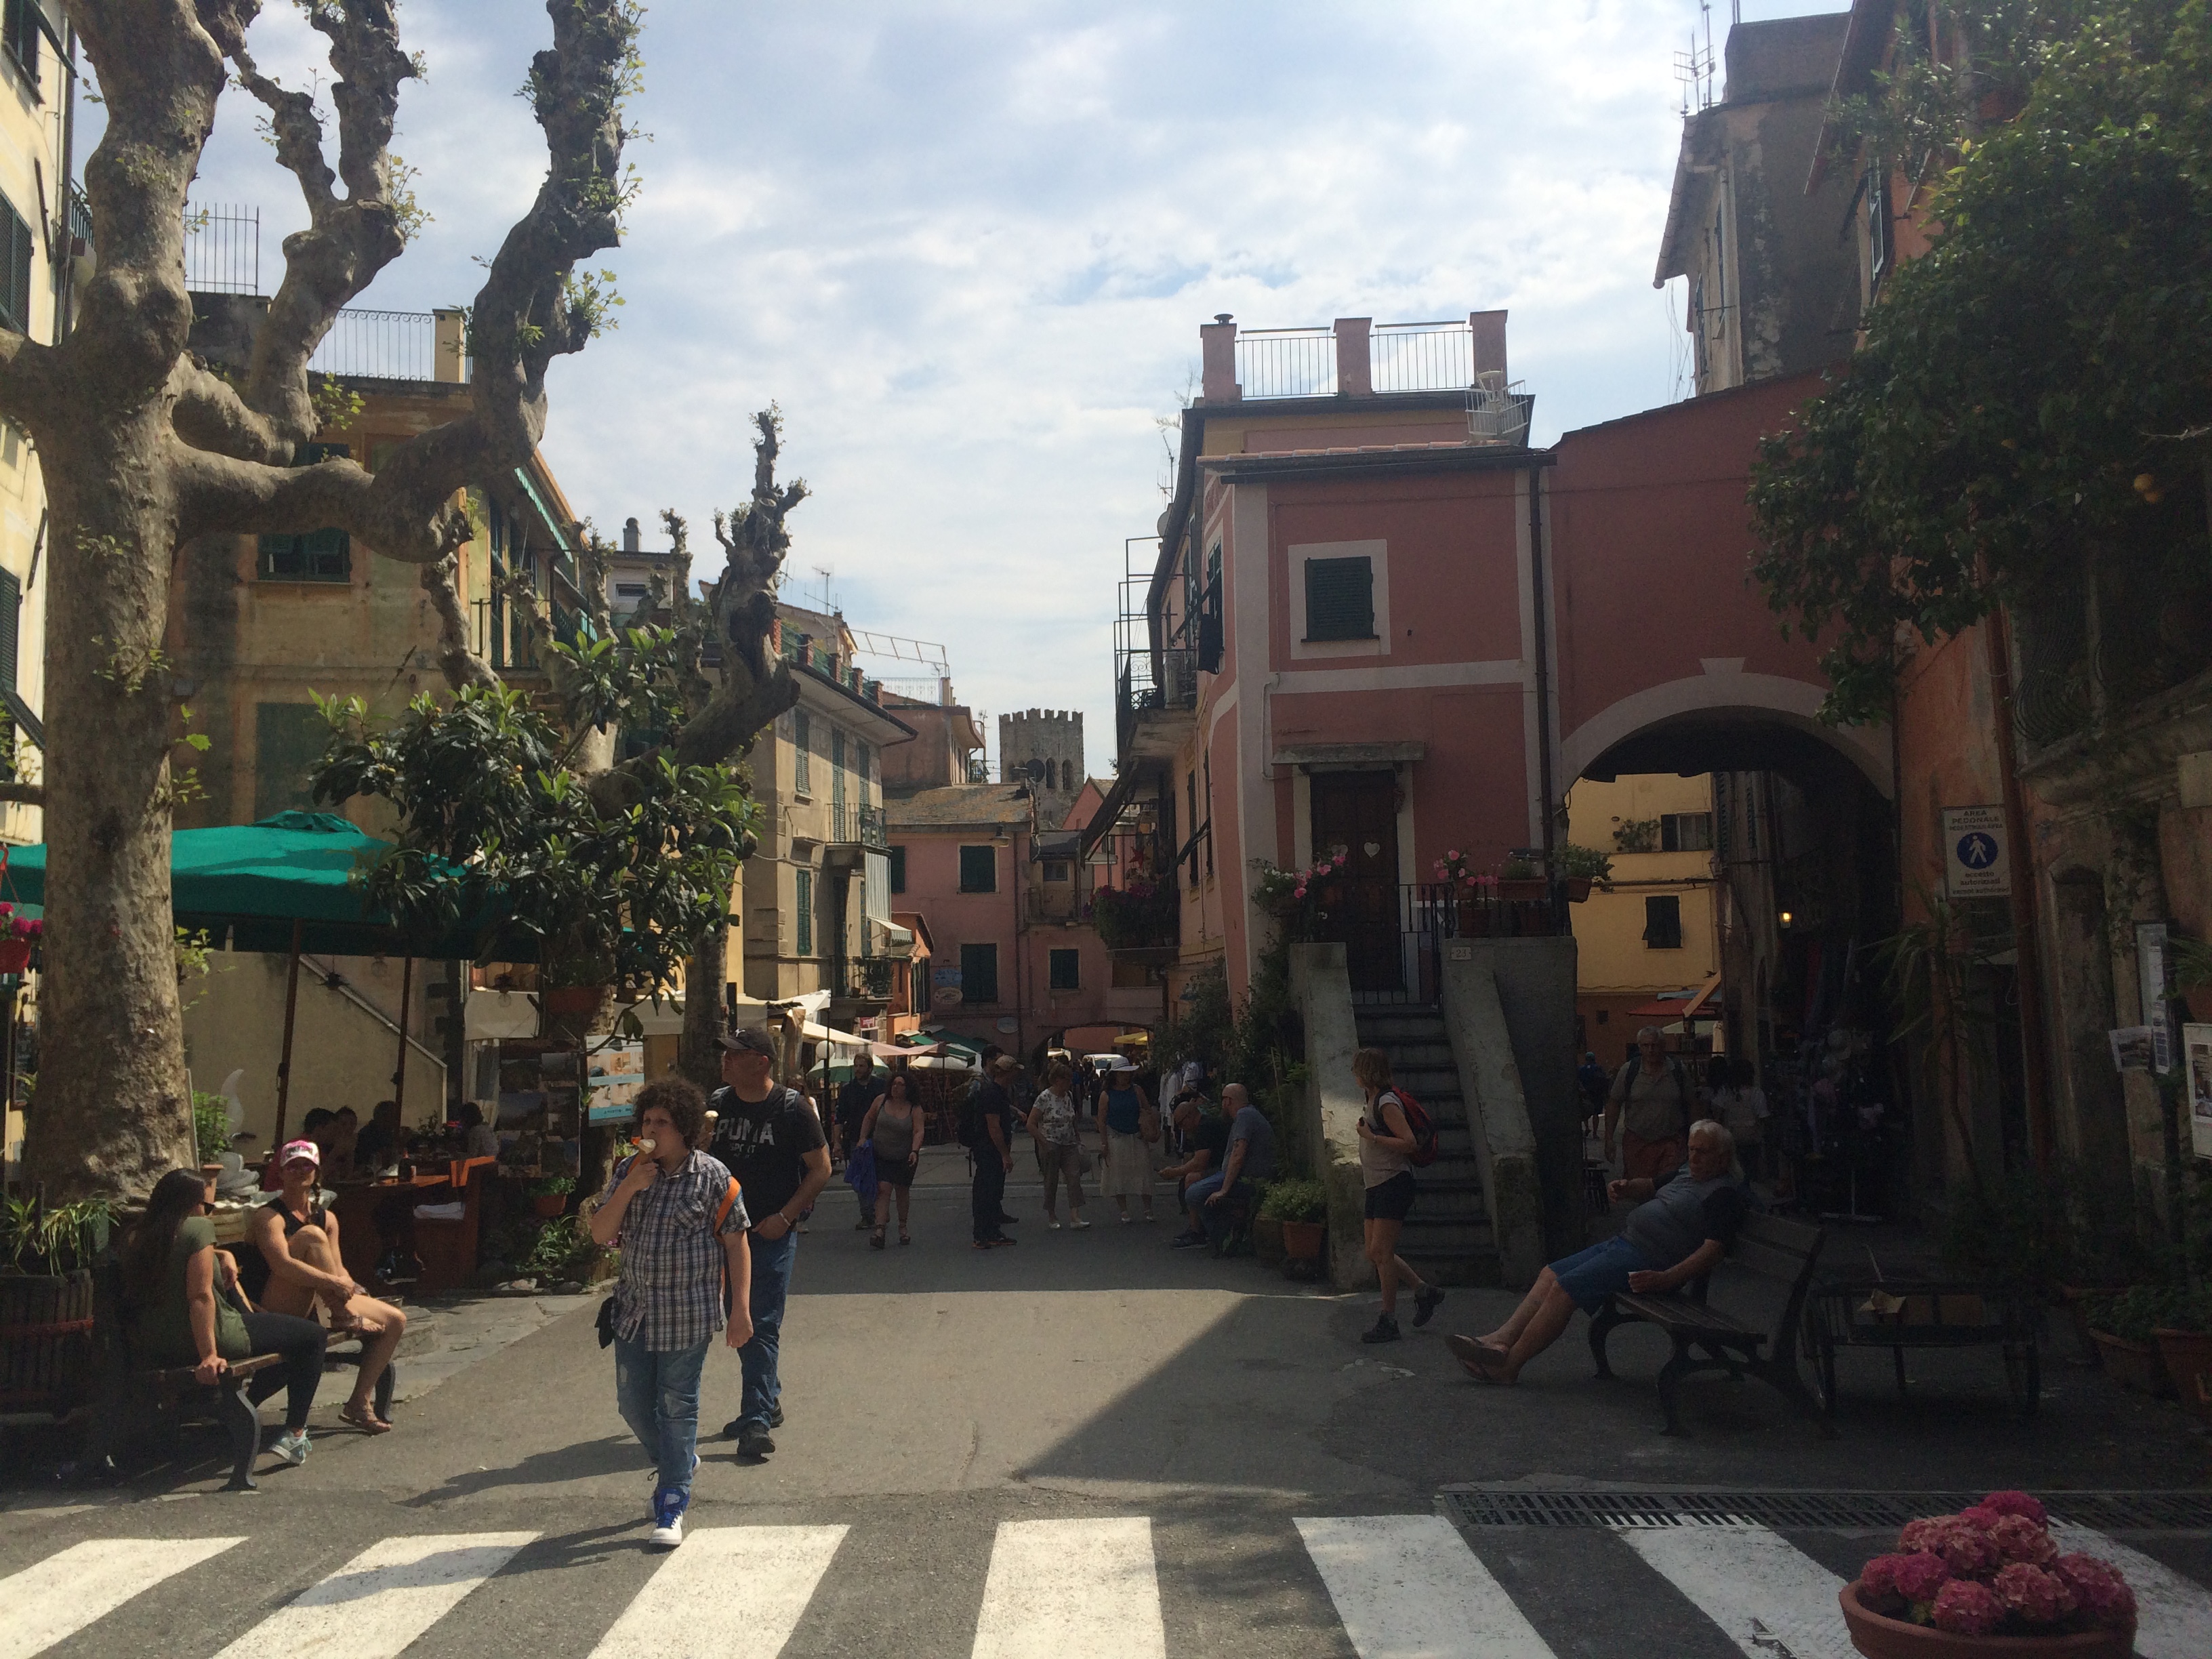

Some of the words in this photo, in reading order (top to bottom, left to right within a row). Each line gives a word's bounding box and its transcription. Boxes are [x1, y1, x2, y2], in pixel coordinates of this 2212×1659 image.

[1952, 816, 2000, 824] PEDONALE
[1456, 949, 1467, 958] 23
[716, 1117, 775, 1145] PUMA
